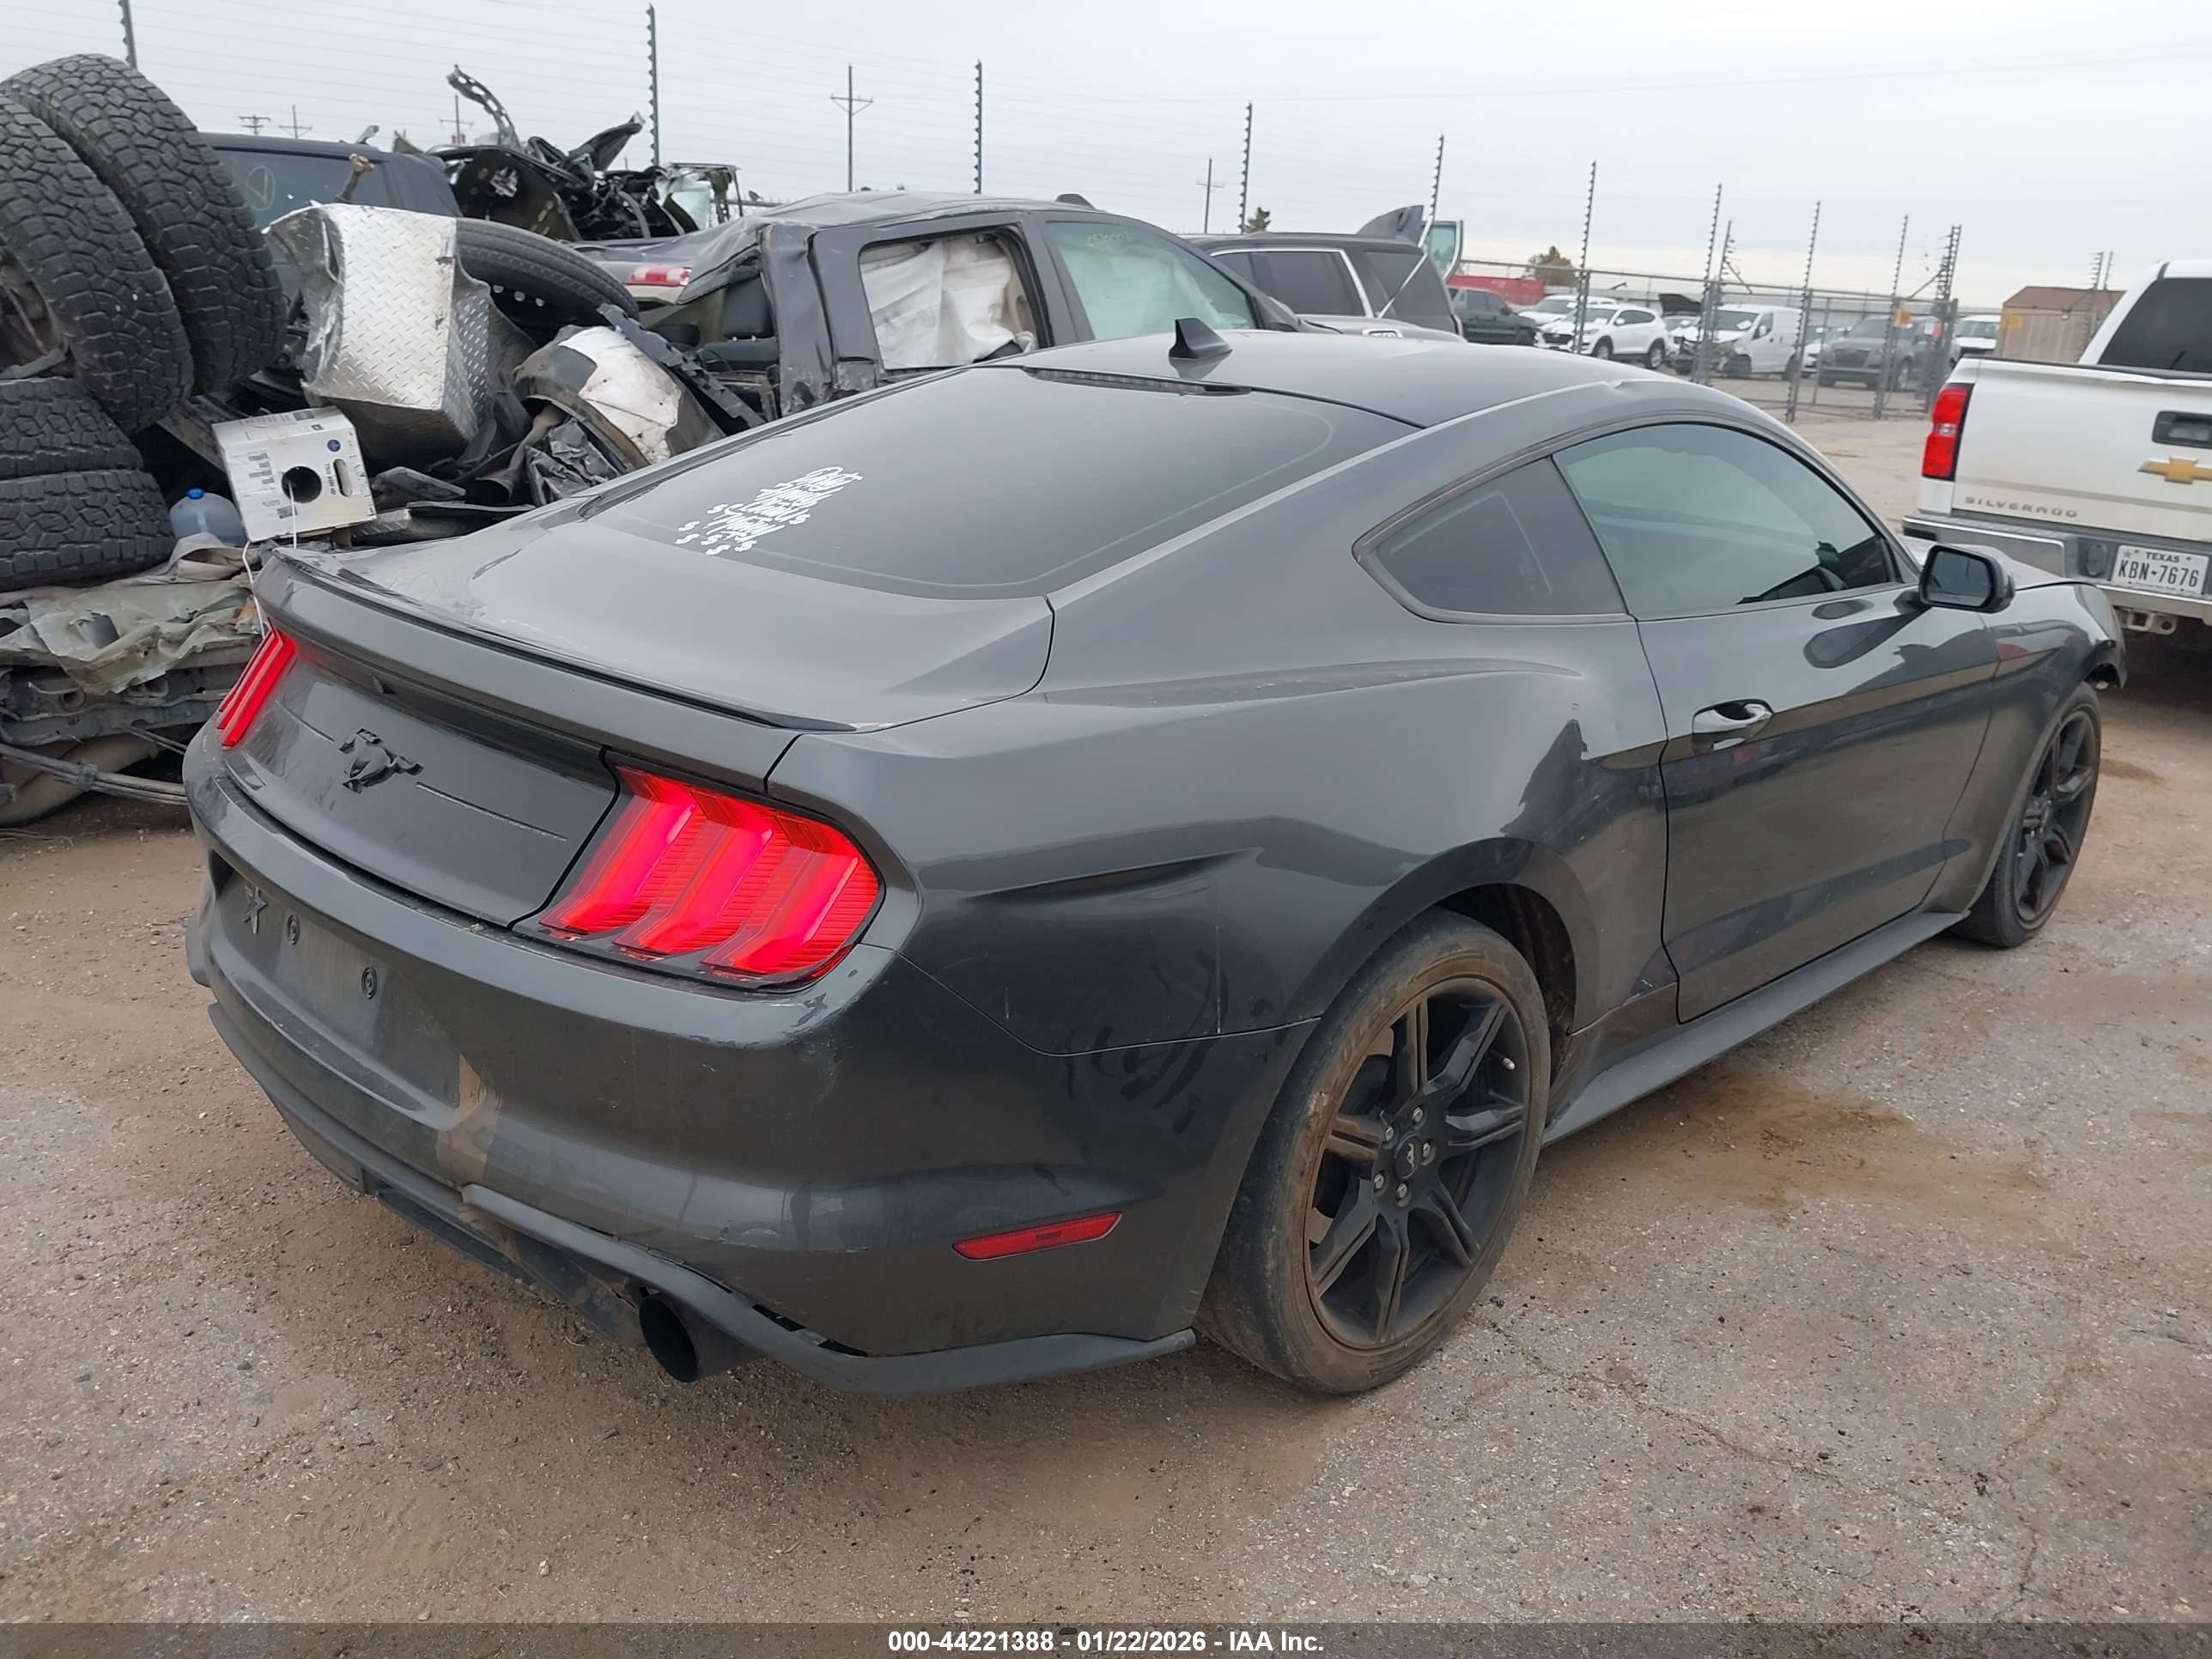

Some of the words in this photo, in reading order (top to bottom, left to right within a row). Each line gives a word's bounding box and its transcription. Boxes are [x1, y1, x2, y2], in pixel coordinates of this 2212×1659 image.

[1964, 496, 2078, 519] SILVERADO
[2146, 551, 2180, 563] TEXAS
[2118, 559, 2200, 588] KBN-7676
